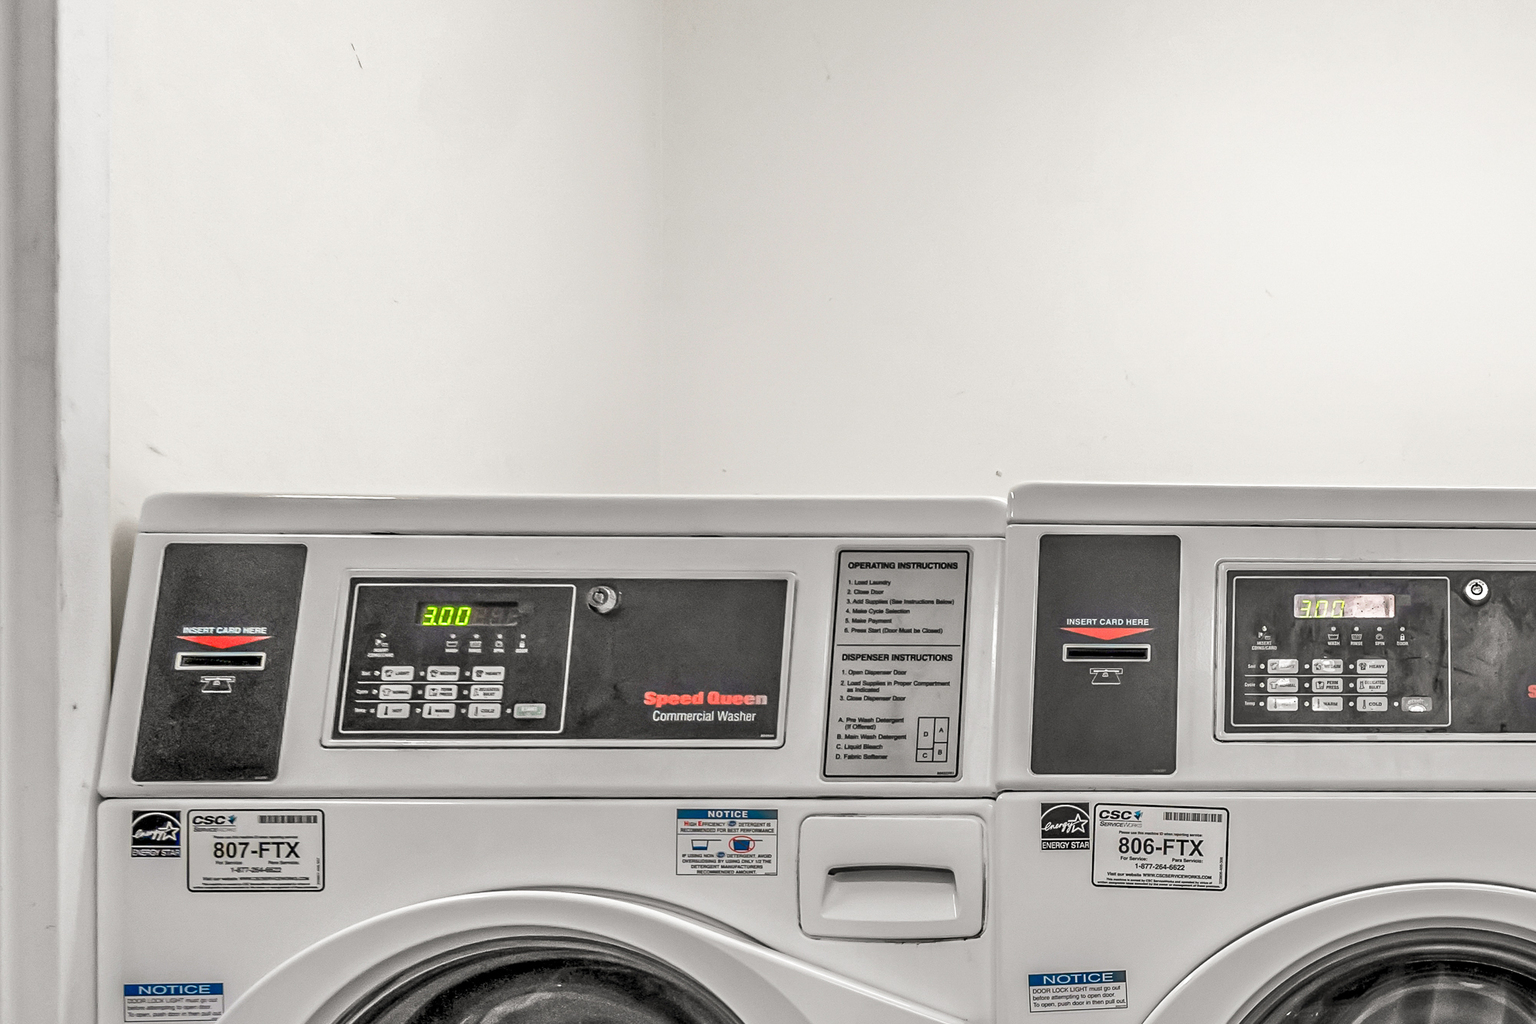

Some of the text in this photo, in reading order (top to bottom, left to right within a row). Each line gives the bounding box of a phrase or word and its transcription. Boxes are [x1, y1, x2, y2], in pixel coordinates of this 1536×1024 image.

[423, 606, 471, 626] 3.00
[644, 691, 767, 708] Speed Queen
[653, 710, 756, 721] Commercial Washer
[193, 816, 225, 825] CSC
[1100, 810, 1131, 820] CSC
[214, 842, 300, 858] 807-FTX
[1071, 841, 1089, 849] STAR
[1118, 837, 1203, 856] 806-FTX
[1043, 973, 1113, 984] NOTICE
[139, 985, 211, 994] NOTICE
